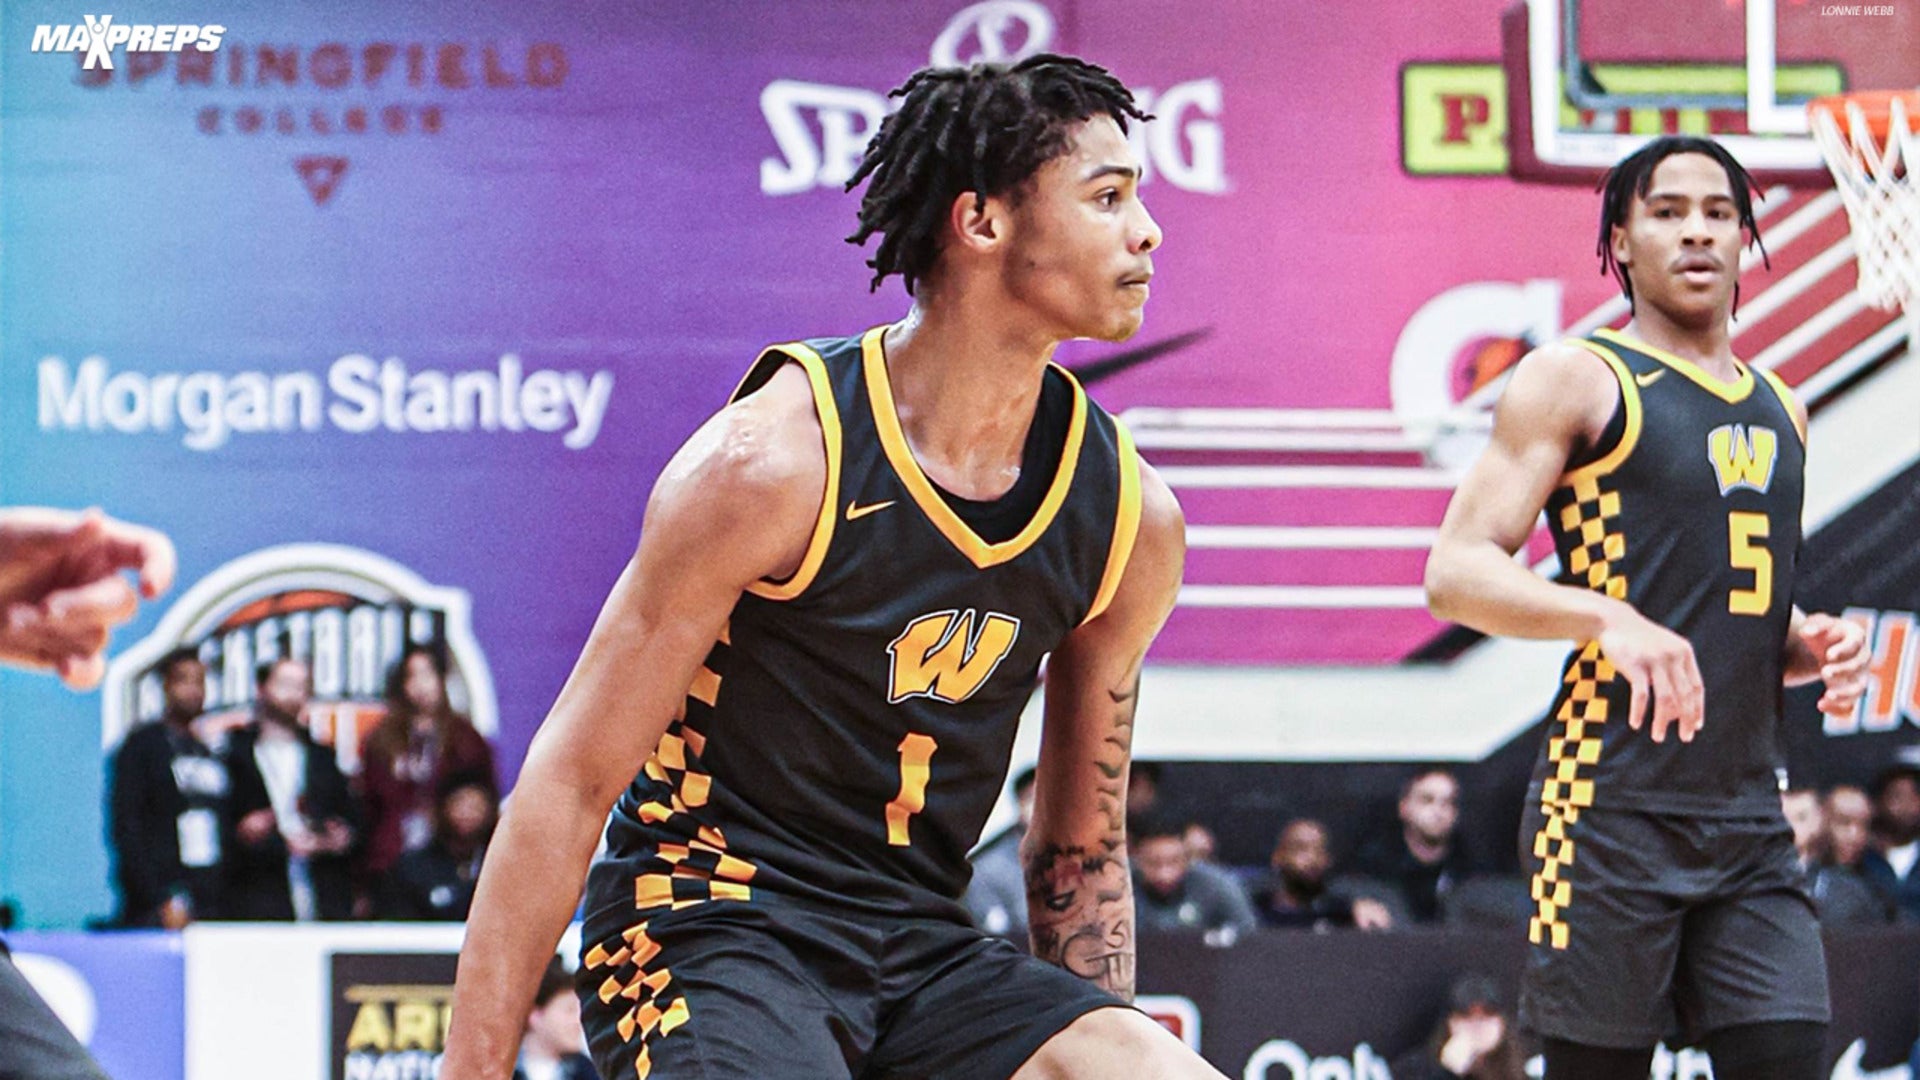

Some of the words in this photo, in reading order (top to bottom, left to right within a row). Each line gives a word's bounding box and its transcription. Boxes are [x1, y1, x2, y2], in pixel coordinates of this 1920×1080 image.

[38, 356, 322, 450] Morgan
[328, 354, 613, 450] Stanley
[1708, 424, 1777, 496] W
[1728, 510, 1773, 616] 5
[886, 608, 1020, 704] W
[885, 732, 938, 846] 1
